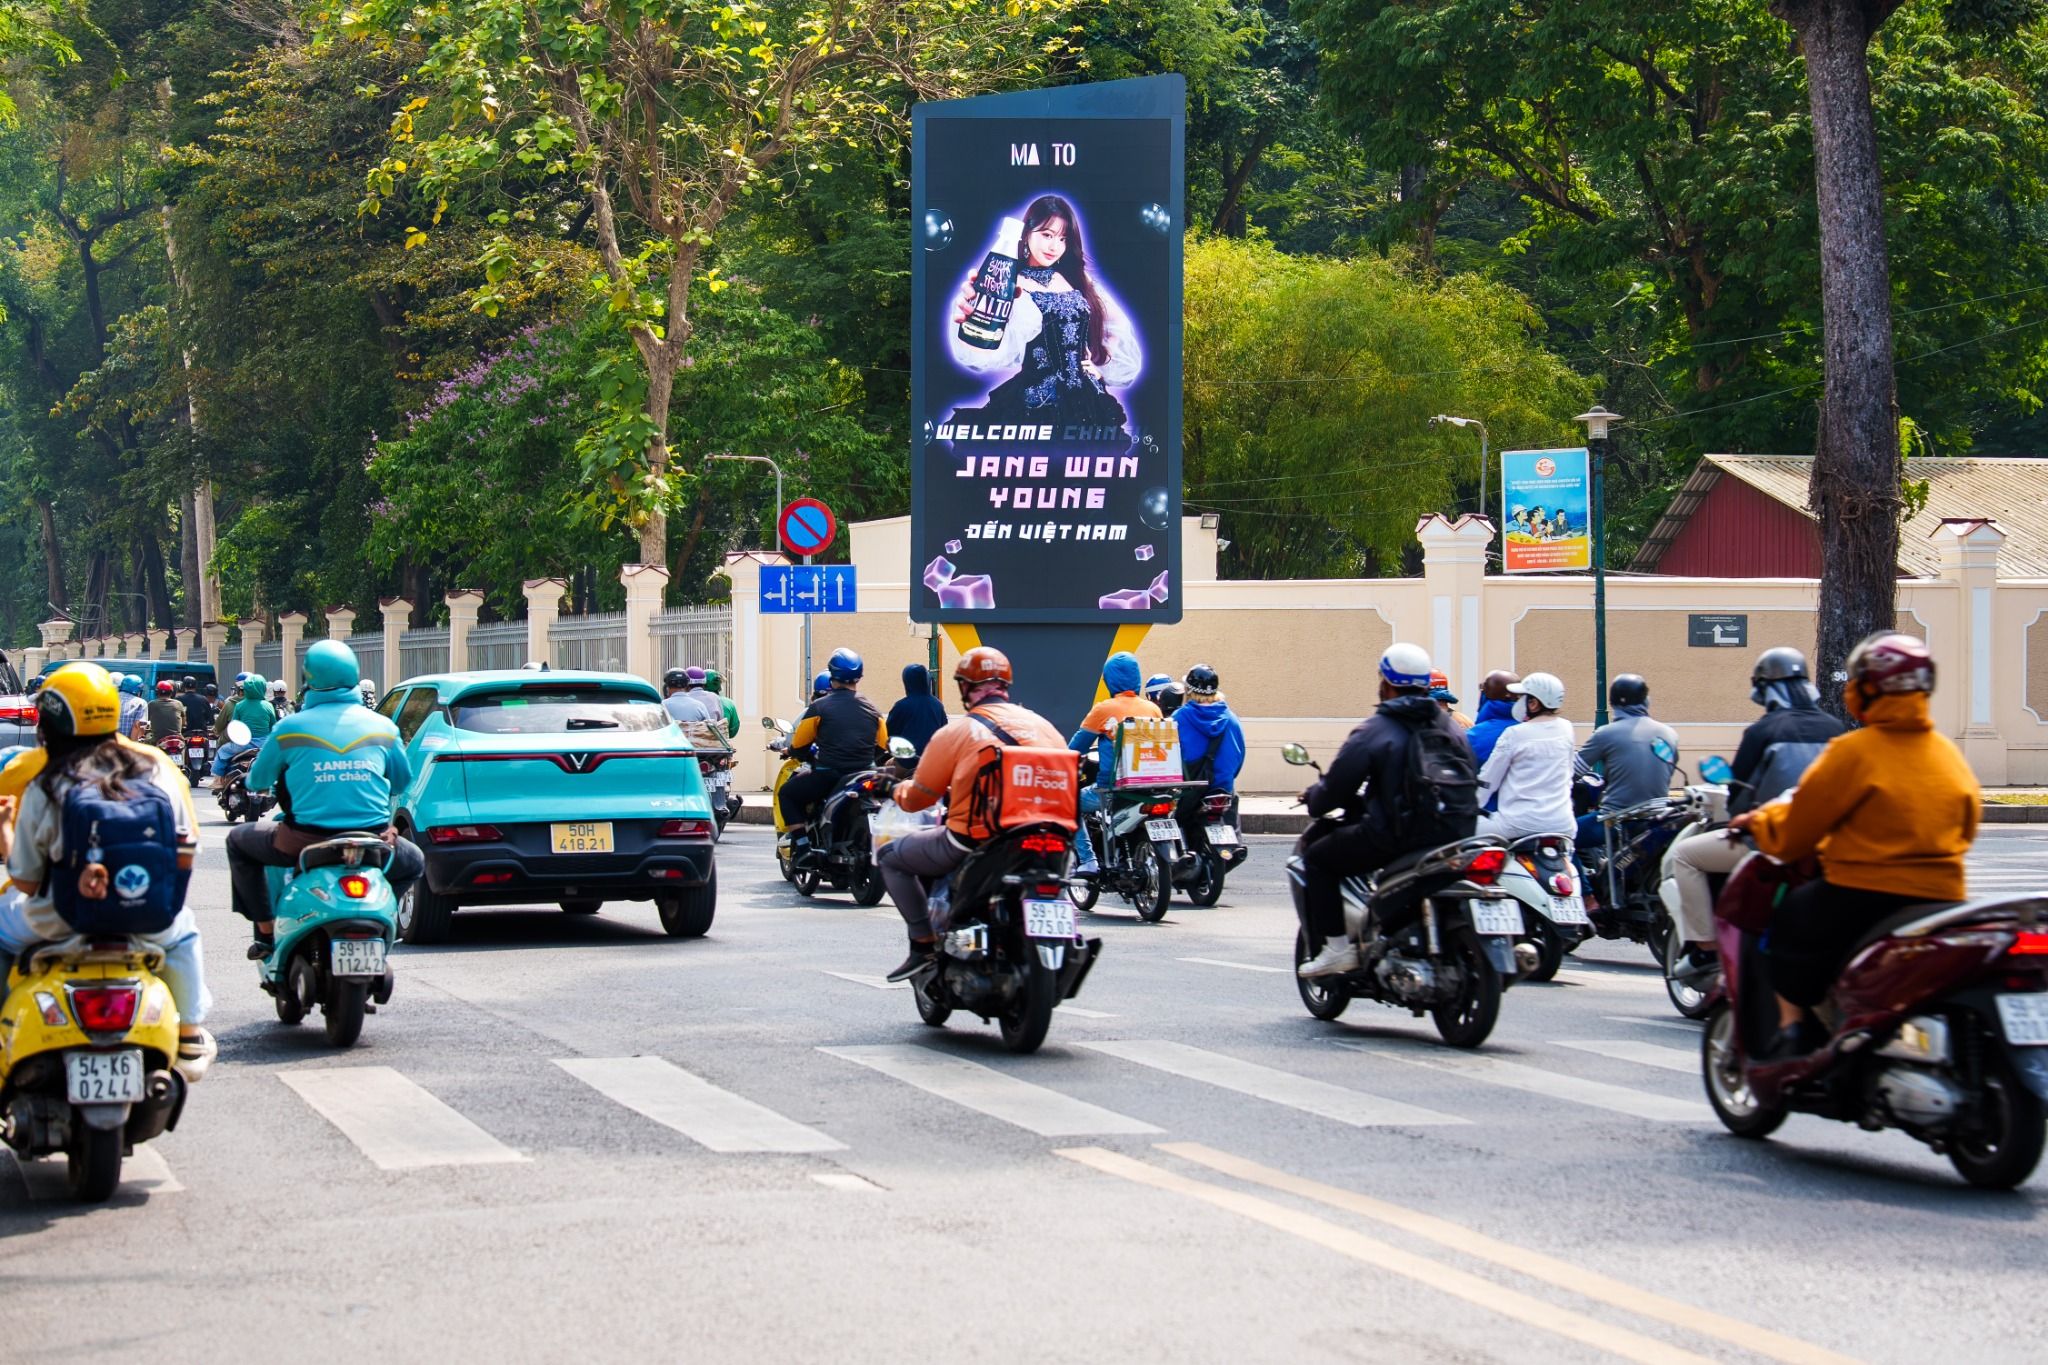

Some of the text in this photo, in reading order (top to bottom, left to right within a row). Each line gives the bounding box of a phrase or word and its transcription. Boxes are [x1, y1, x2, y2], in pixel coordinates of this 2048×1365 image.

[936, 425, 1053, 441] WELCOME
[956, 456, 1139, 478] JANG WON
[990, 487, 1106, 509] YOUNG
[964, 520, 1128, 543] ĐẾN VIỆT NAM
[1034, 776, 1068, 790] Food
[568, 824, 596, 837] 50H
[559, 838, 605, 850] 418.21
[1031, 903, 1067, 919] 59-T2
[1029, 919, 1073, 935] 275.03
[339, 942, 376, 957] 59-TA
[337, 958, 381, 973] 112.42
[79, 1056, 131, 1077] 54-K6
[79, 1078, 132, 1099] 0244
